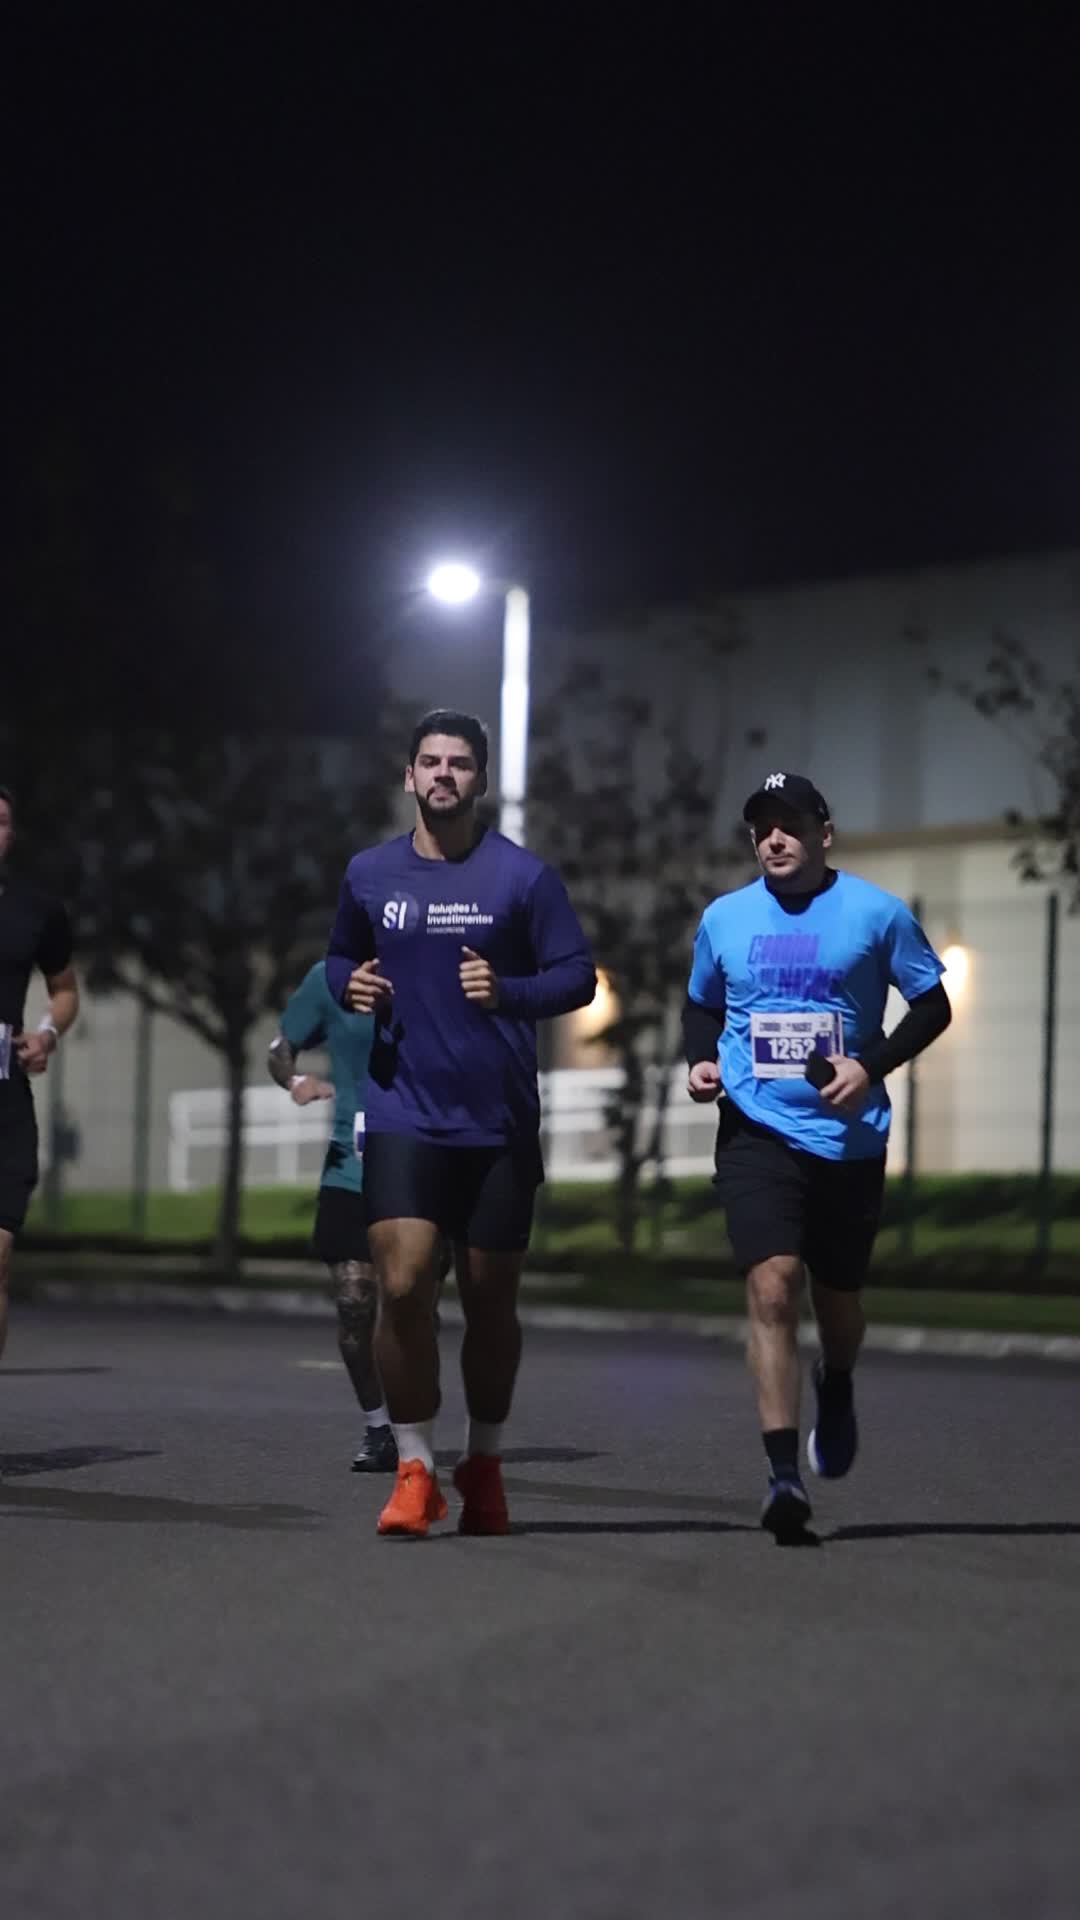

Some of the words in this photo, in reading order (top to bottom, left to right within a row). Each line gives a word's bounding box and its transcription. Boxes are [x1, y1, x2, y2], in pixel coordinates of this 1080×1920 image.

[764, 772, 786, 791] NY
[428, 902, 470, 915] Soluções
[768, 1037, 816, 1060] 1252
